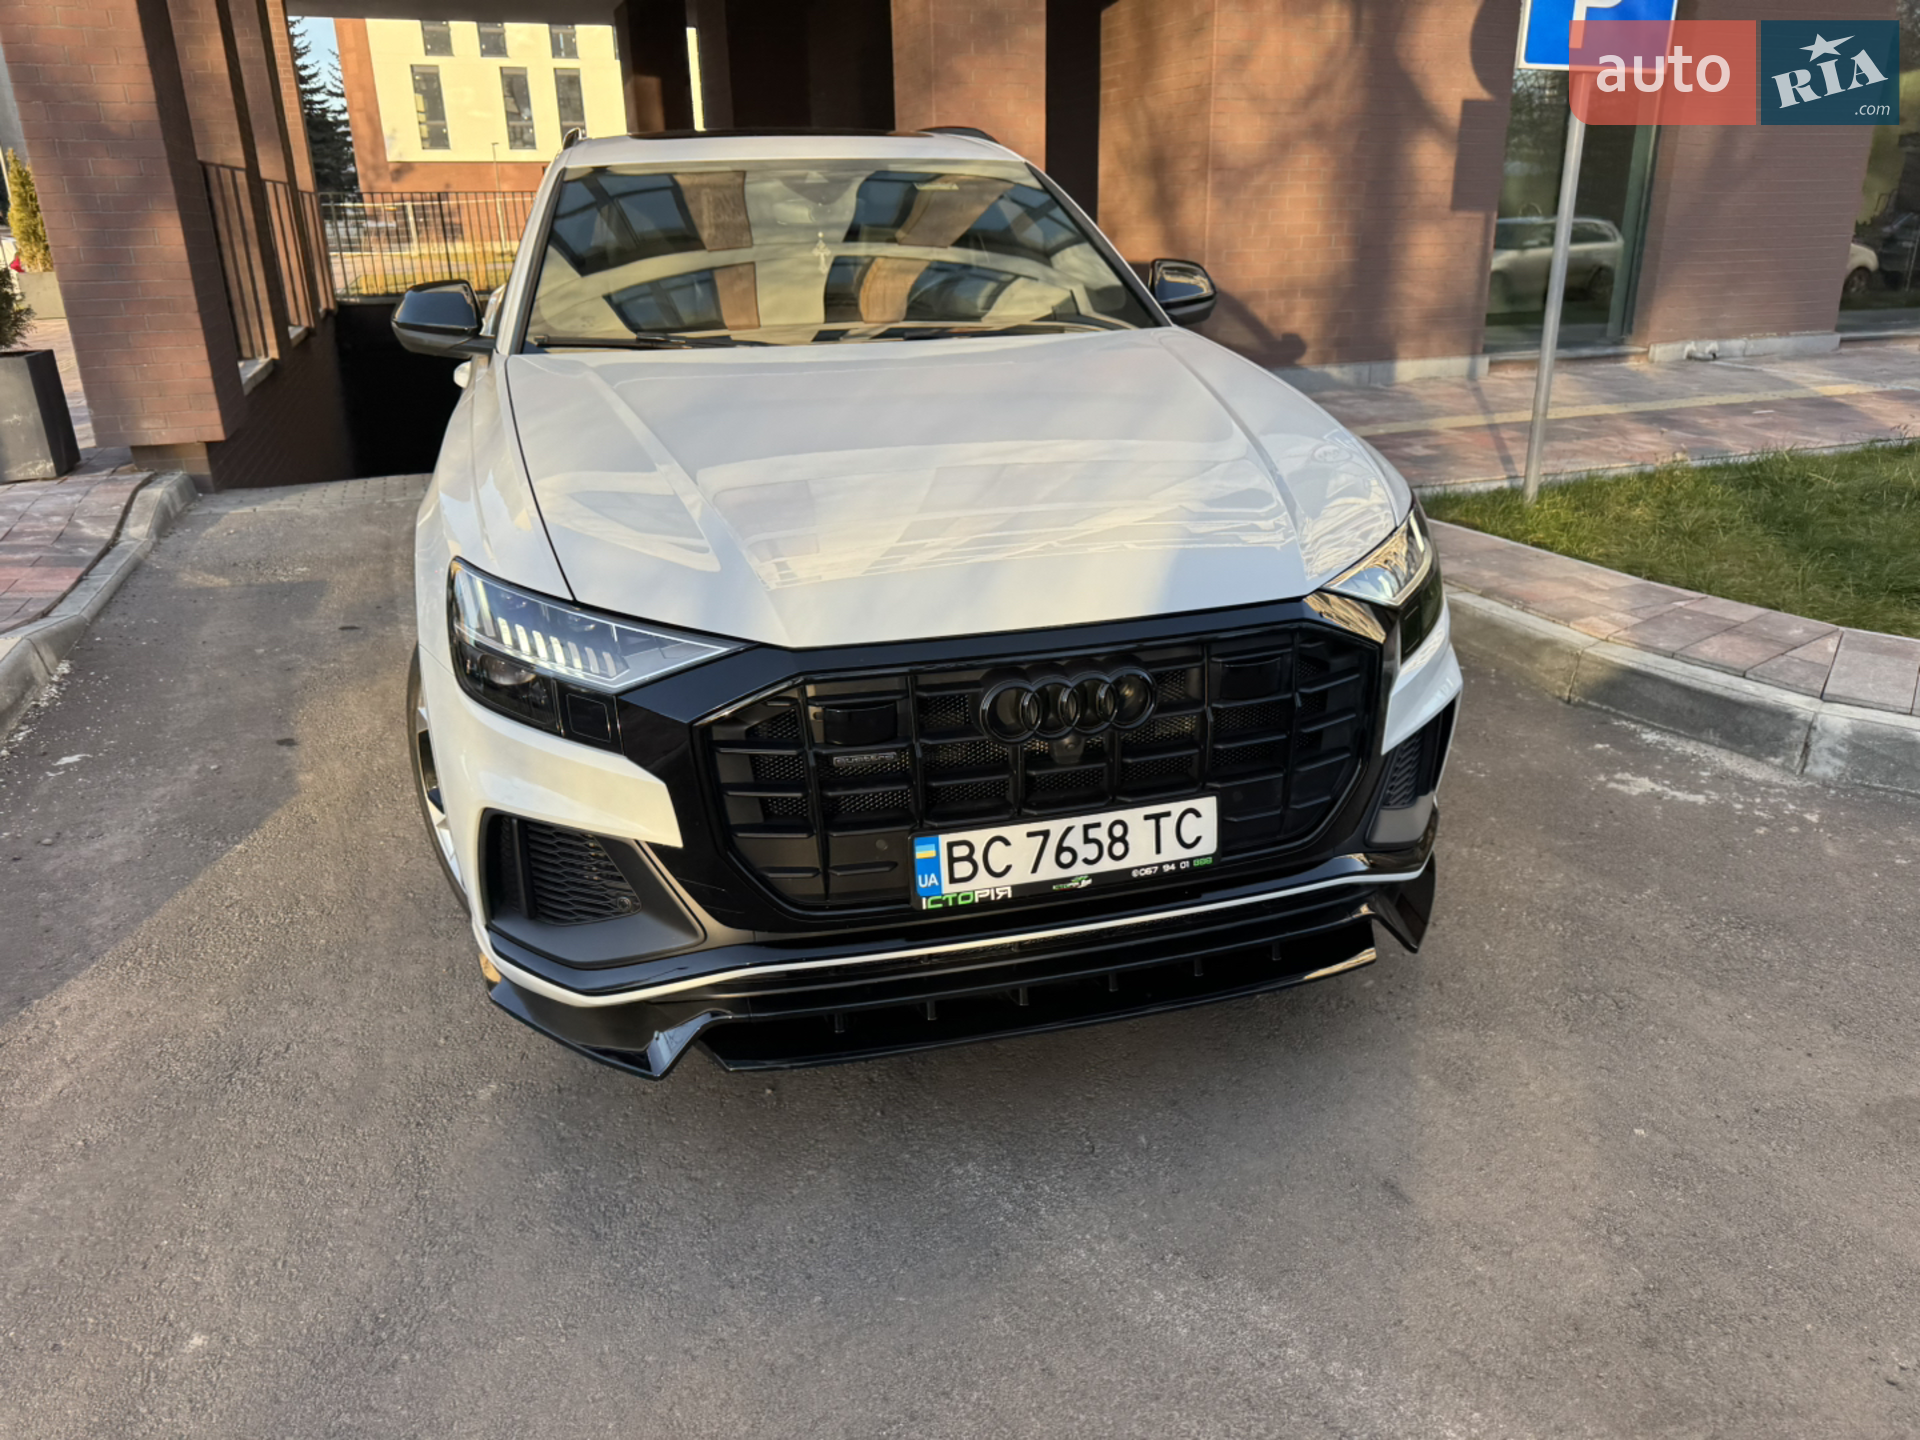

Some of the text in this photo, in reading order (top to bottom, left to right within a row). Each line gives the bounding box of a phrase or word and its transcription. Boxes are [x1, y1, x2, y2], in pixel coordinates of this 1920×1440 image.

[946, 807, 1203, 884] BC 7658 TC
[918, 873, 939, 888] UA
[922, 886, 1012, 910] ІСТОРІЯ
